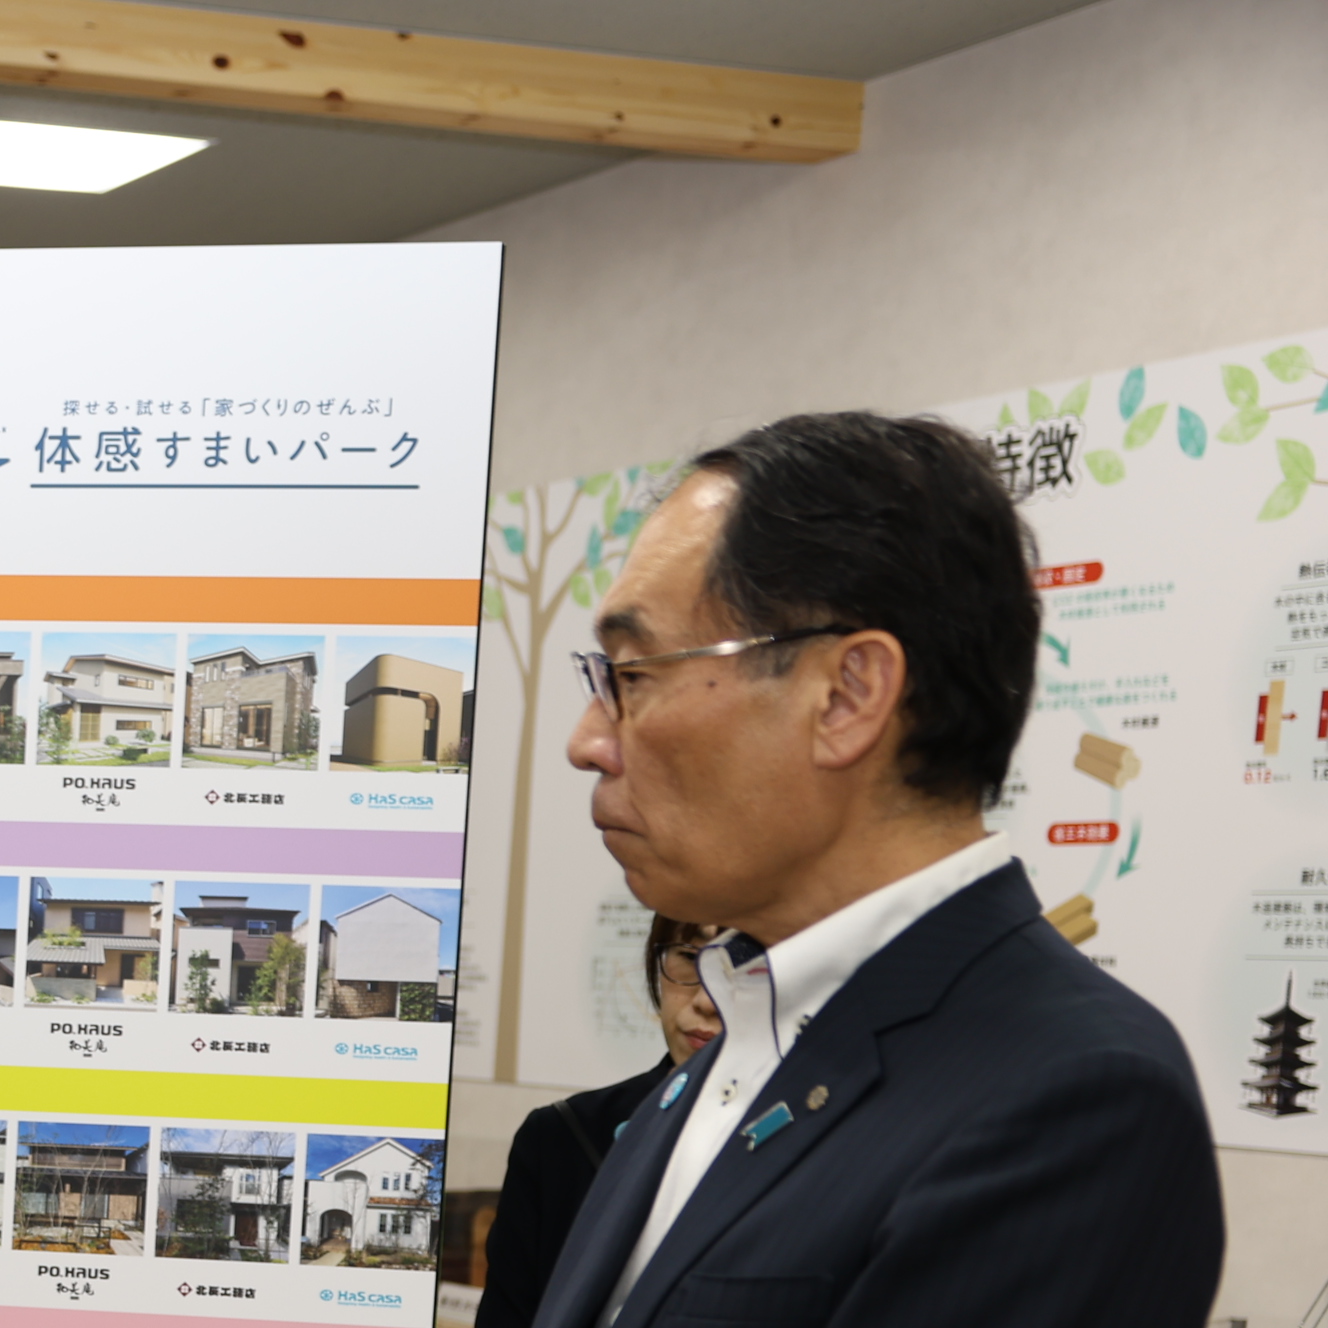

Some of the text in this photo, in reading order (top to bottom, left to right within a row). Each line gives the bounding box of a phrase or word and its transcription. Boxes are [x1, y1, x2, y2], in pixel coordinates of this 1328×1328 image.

[62, 397, 395, 418] 探せる・試せる「家づくりのぜんぶ」
[34, 426, 419, 474] 体感すまいパーク
[1299, 561, 1328, 580] 熱伝
[398, 796, 434, 806] casa
[384, 1046, 419, 1058] casa
[368, 1293, 403, 1304] casa
